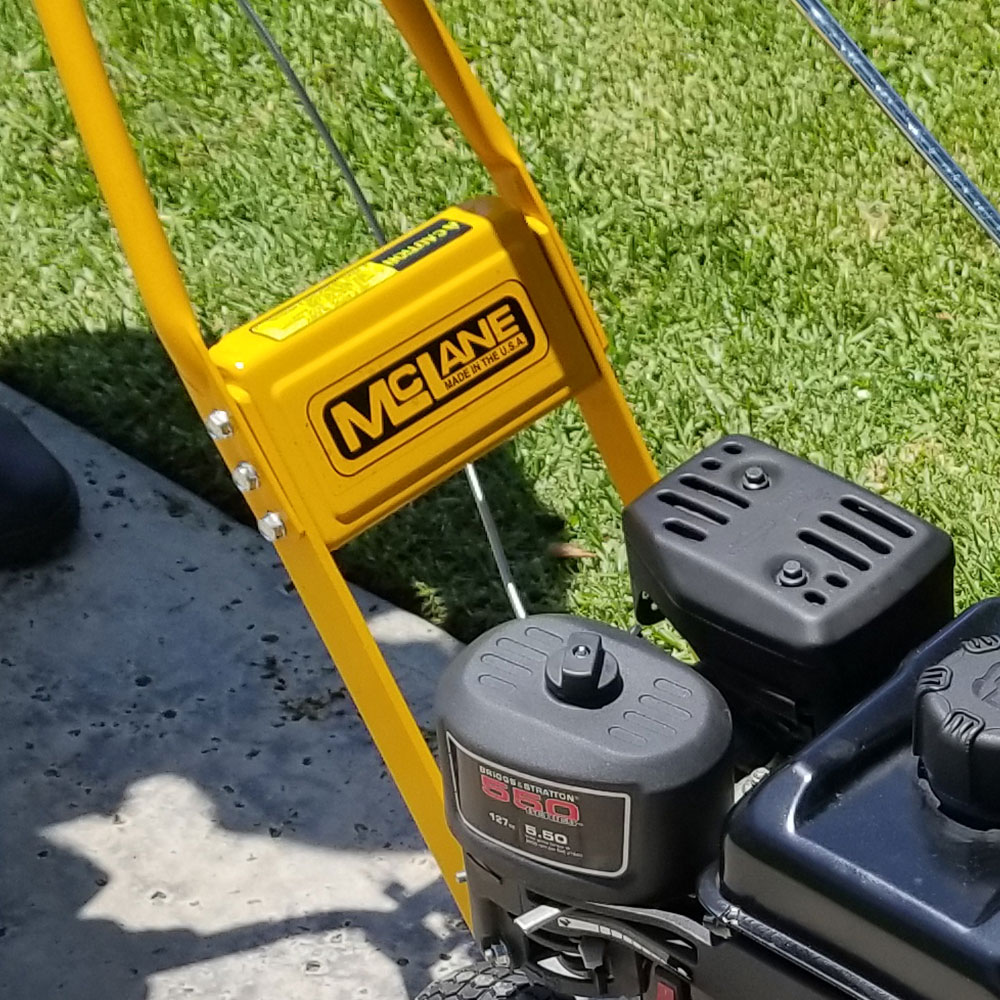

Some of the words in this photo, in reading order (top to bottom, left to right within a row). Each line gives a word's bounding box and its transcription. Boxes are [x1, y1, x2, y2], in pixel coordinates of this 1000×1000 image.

[444, 367, 472, 390] MADE
[470, 361, 482, 375] IN
[481, 350, 500, 367] THE
[479, 765, 516, 786] BRIGGS
[480, 773, 580, 823] 550
[525, 823, 567, 845] 5.50
